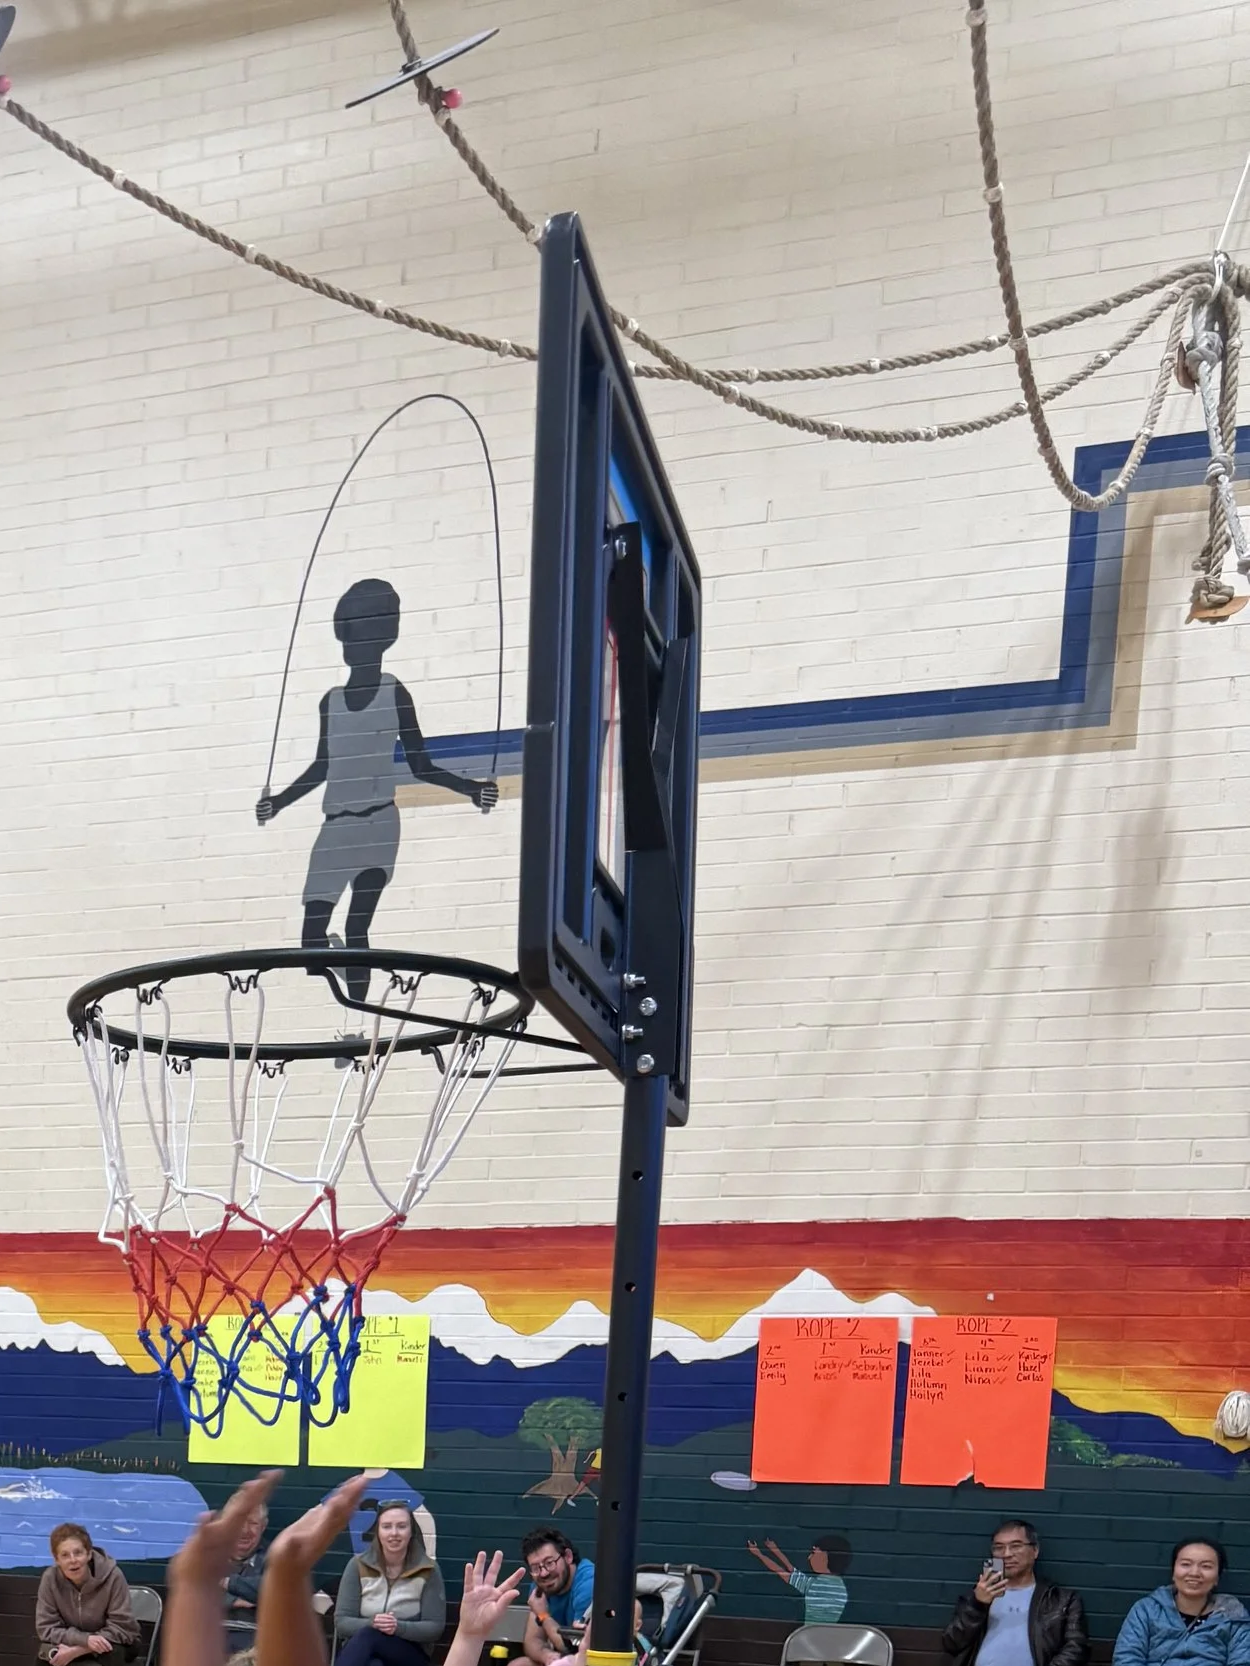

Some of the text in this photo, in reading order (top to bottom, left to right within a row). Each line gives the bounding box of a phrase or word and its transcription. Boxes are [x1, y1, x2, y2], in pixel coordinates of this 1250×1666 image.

[796, 1318, 838, 1339] ROPE
[956, 1317, 993, 1333] ROPE
[400, 1339, 427, 1350] Kinder
[859, 1343, 893, 1355] Kinder
[964, 1374, 991, 1384] Nina
[1016, 1373, 1044, 1382] Carlos
[910, 1379, 947, 1390] Autumn
